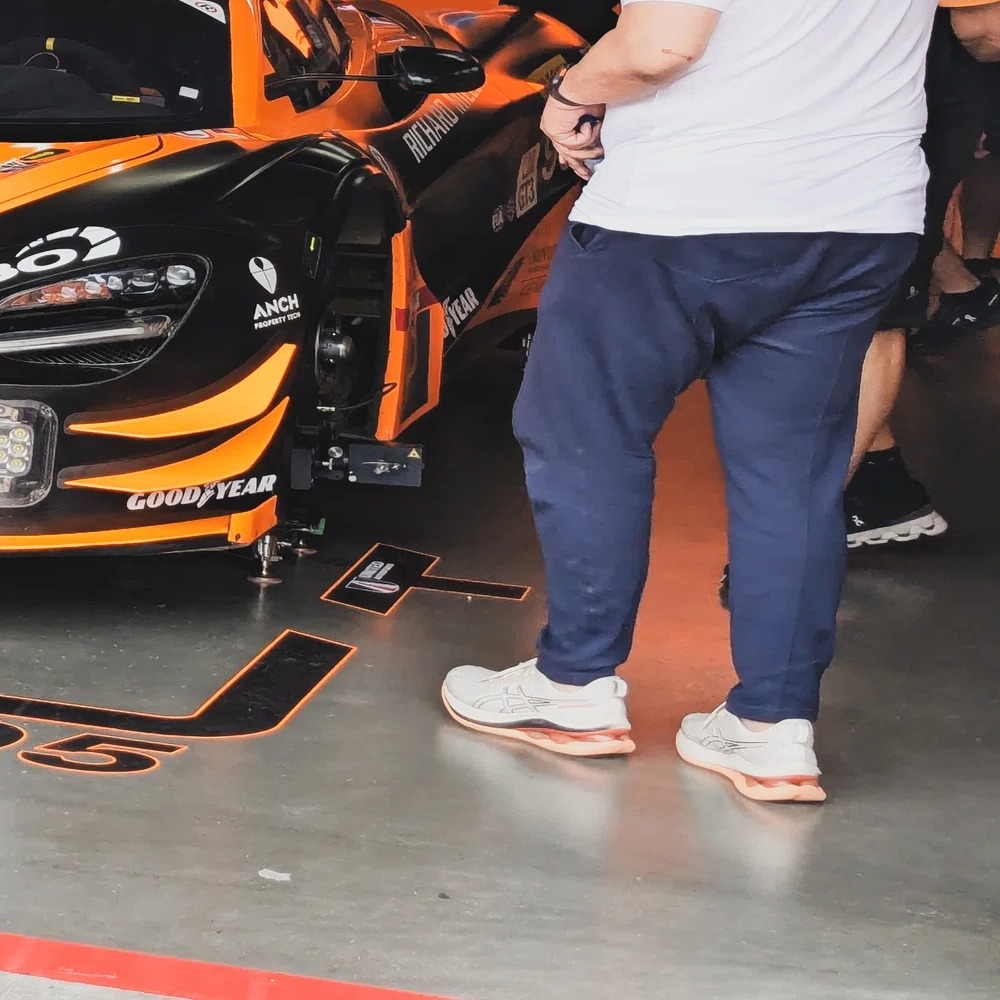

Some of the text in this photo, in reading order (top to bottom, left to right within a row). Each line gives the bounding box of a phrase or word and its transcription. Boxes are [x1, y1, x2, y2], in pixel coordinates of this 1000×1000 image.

[402, 98, 459, 163] RICHARD
[253, 293, 300, 320] ANCH
[254, 315, 287, 330] PROPERTY
[126, 474, 277, 511] GOODYEAR
